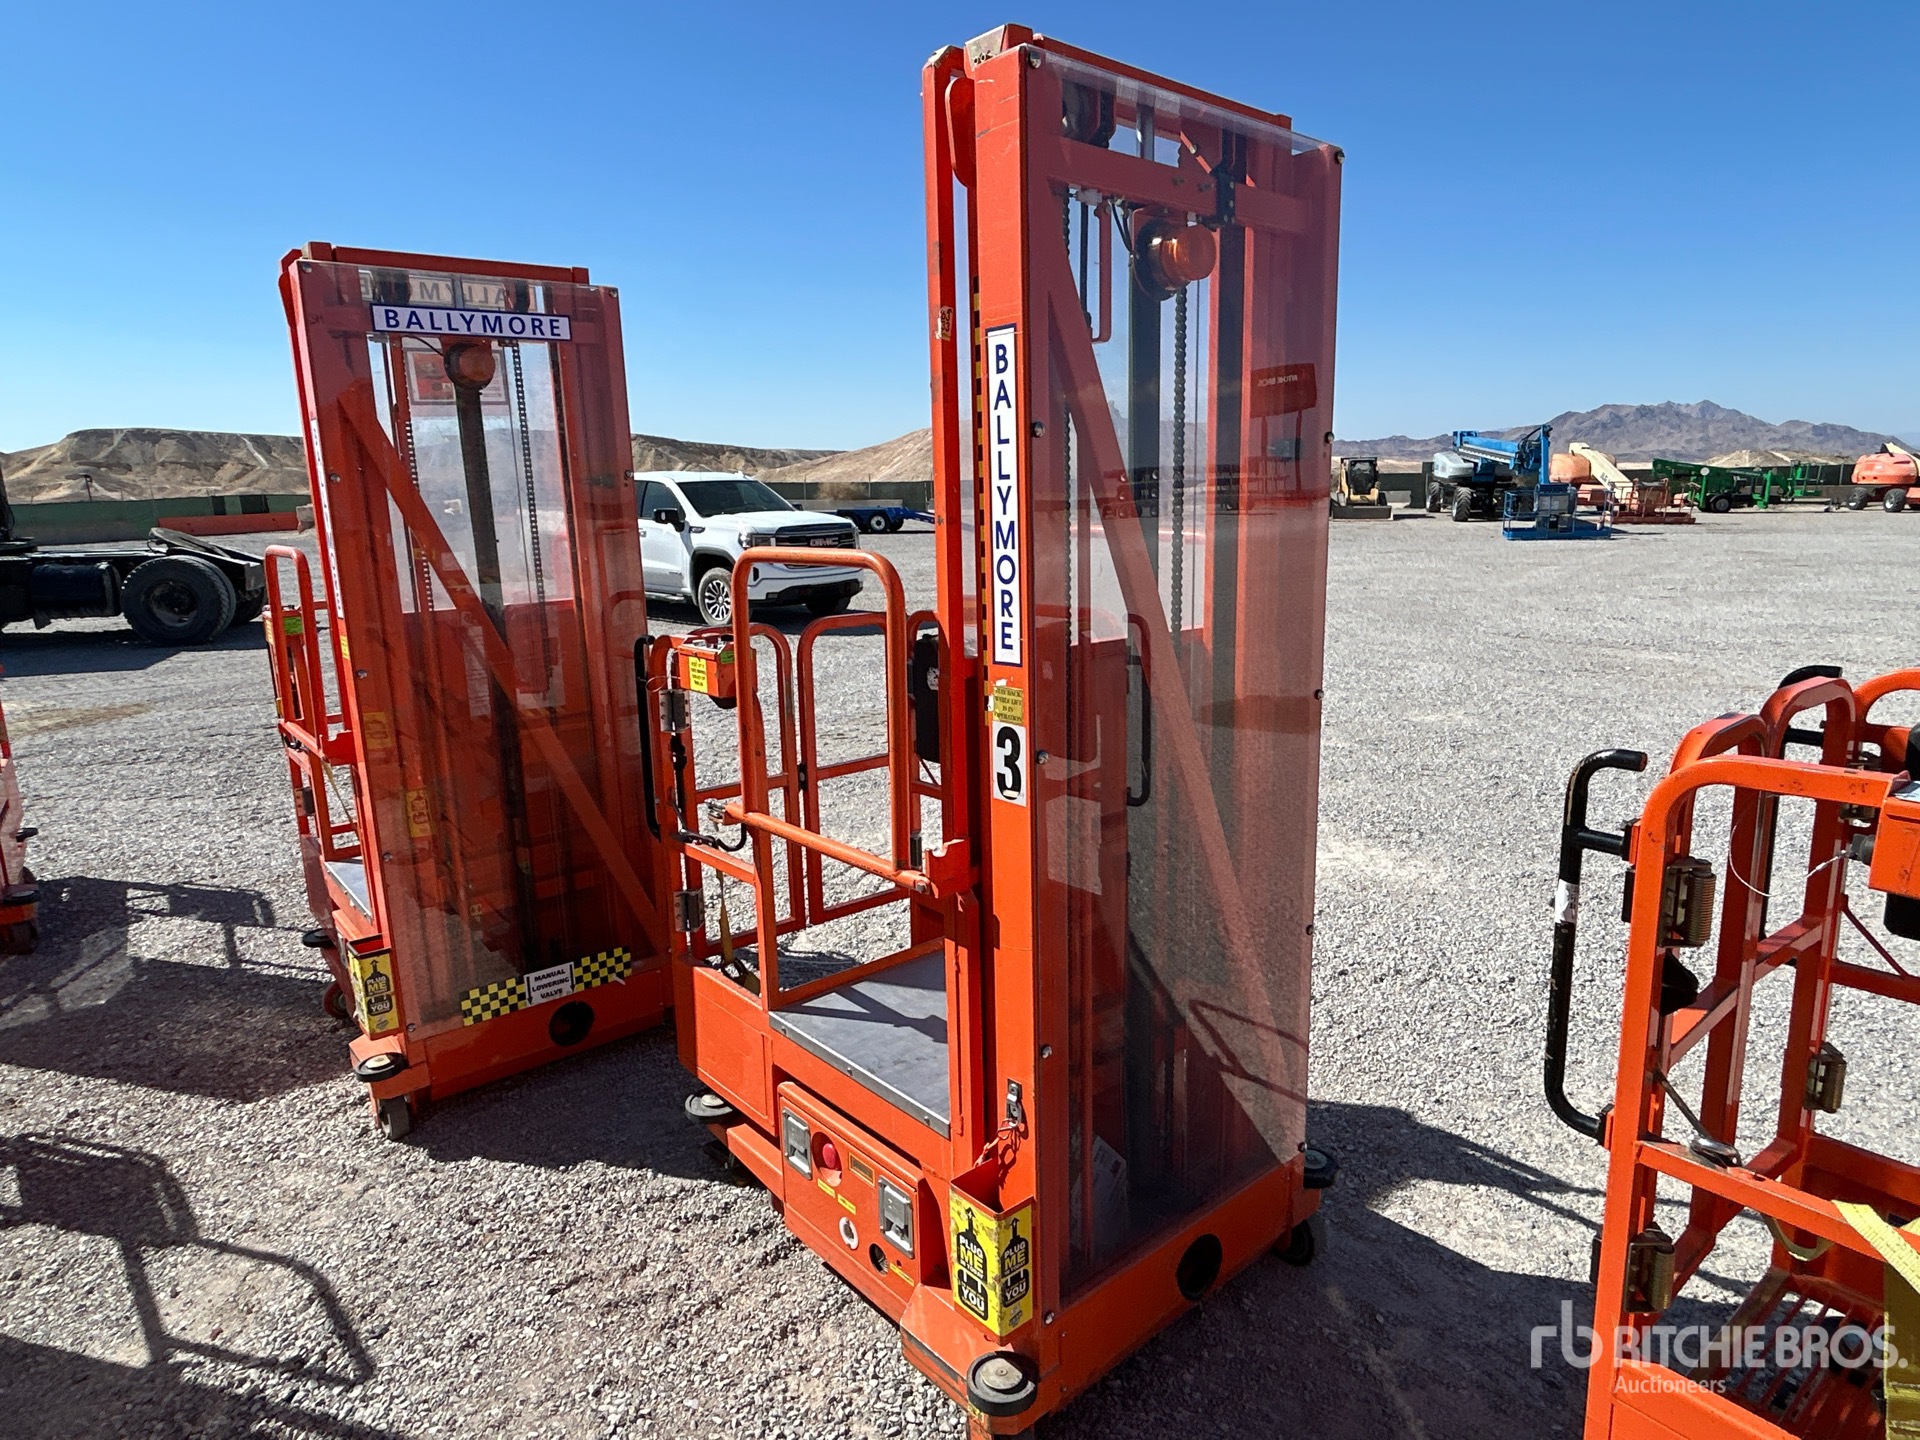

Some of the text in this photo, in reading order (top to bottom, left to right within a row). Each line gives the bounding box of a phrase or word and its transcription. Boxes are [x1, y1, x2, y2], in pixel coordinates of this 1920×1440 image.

[383, 308, 562, 337] BALLYMORE
[993, 343, 1016, 651] BALLYMORE
[996, 726, 1022, 801] 3
[366, 975, 387, 985] PLUG
[531, 976, 570, 992] LOWERING
[534, 969, 566, 982] MANUAL
[368, 982, 387, 993] ME
[540, 988, 563, 999] VALVE
[371, 1001, 390, 1012] YOU
[959, 1234, 984, 1259] PLUG
[1004, 1240, 1026, 1259] PLUG
[960, 1245, 984, 1275] ME
[1004, 1248, 1026, 1271] ME
[961, 1285, 985, 1312] YOU
[1006, 1281, 1027, 1301] YOU
